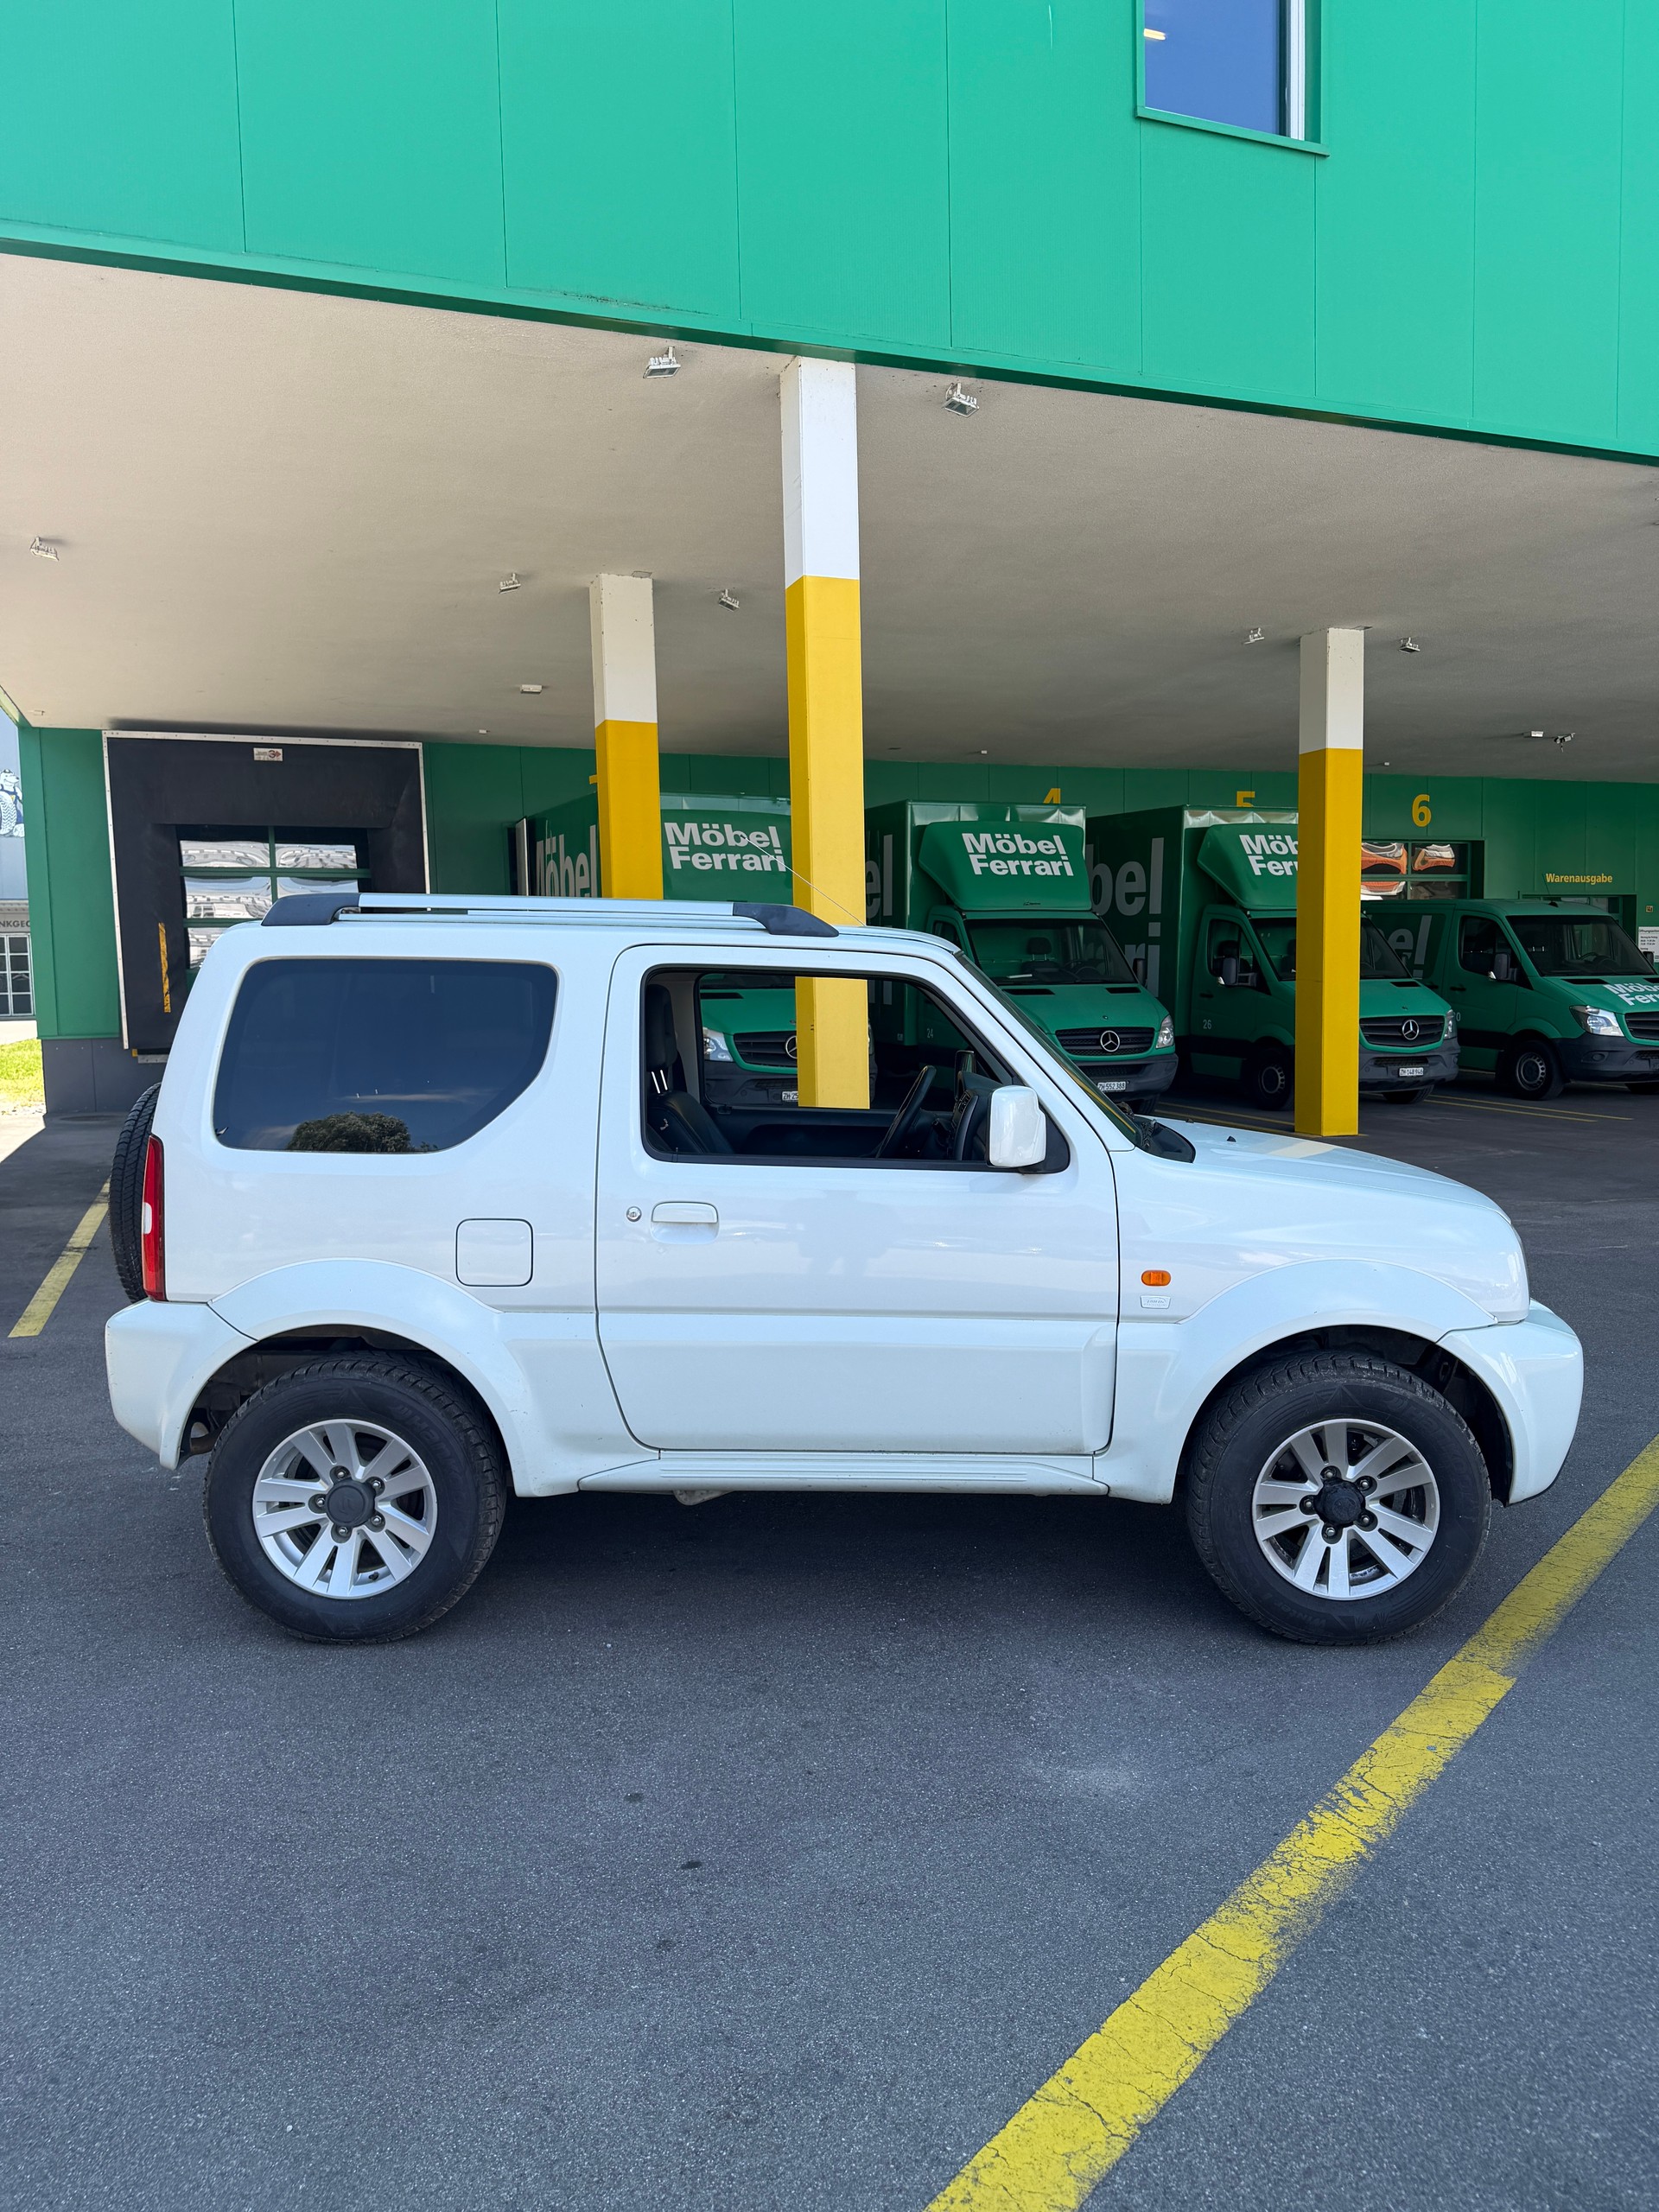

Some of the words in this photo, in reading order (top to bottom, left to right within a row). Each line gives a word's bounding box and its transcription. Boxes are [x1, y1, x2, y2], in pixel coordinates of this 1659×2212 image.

[1412, 793, 1432, 827] 6
[664, 822, 781, 848] Möbel
[962, 833, 1067, 855] Möbel
[669, 846, 787, 872] Ferrari
[969, 855, 1074, 876] Ferrari
[1546, 873, 1613, 886] Warenausgabe
